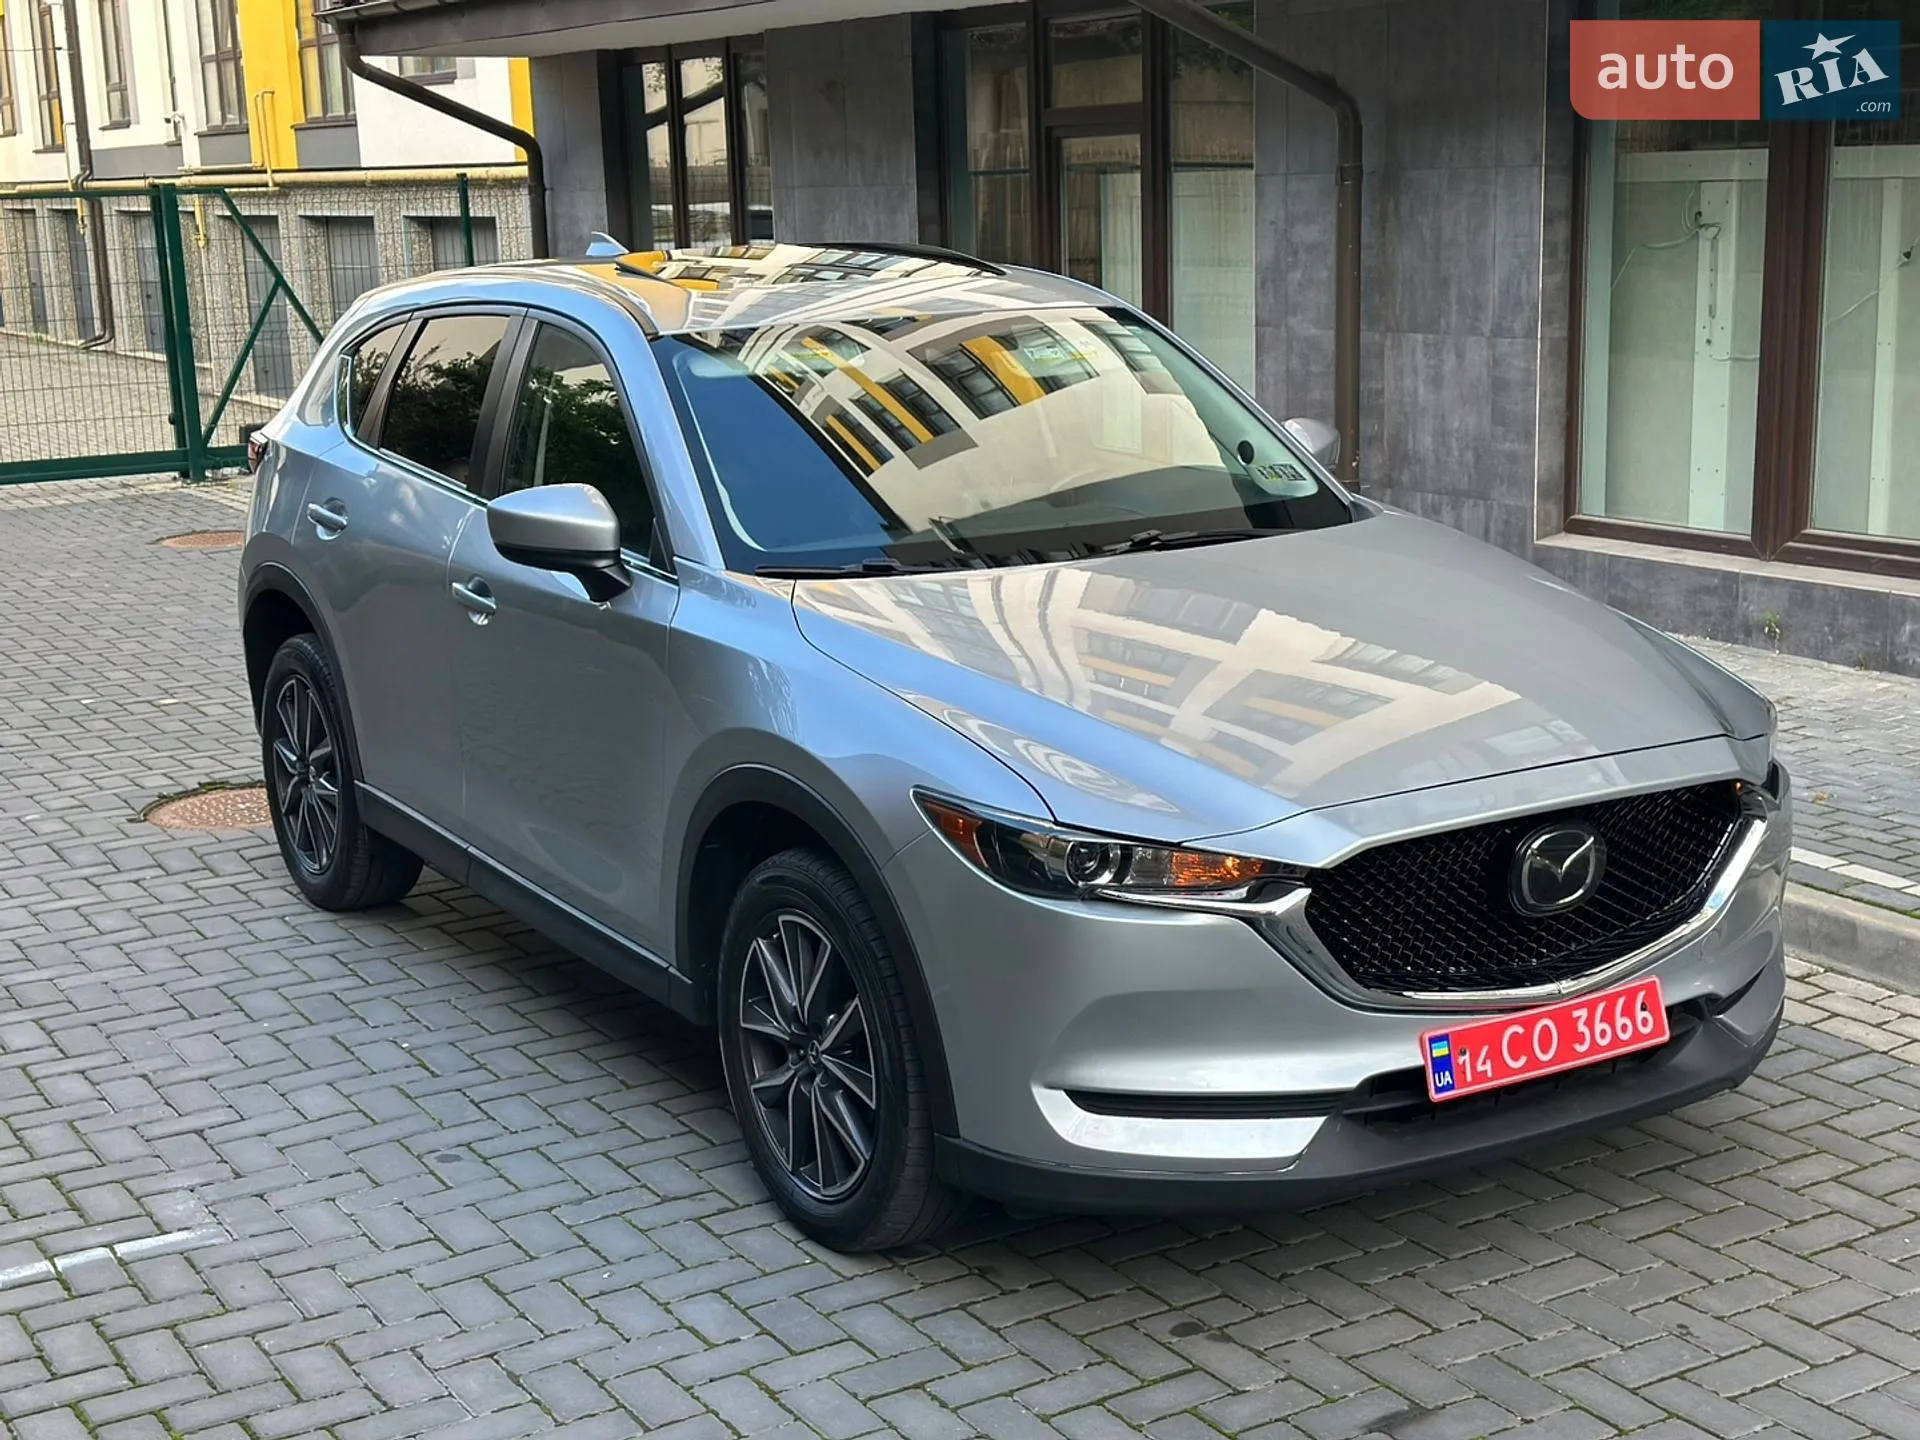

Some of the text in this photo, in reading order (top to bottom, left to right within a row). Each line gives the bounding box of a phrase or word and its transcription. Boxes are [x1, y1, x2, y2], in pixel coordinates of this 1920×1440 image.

[1458, 990, 1654, 1083] 14 CO 3666
[1434, 1071, 1453, 1088] UA
